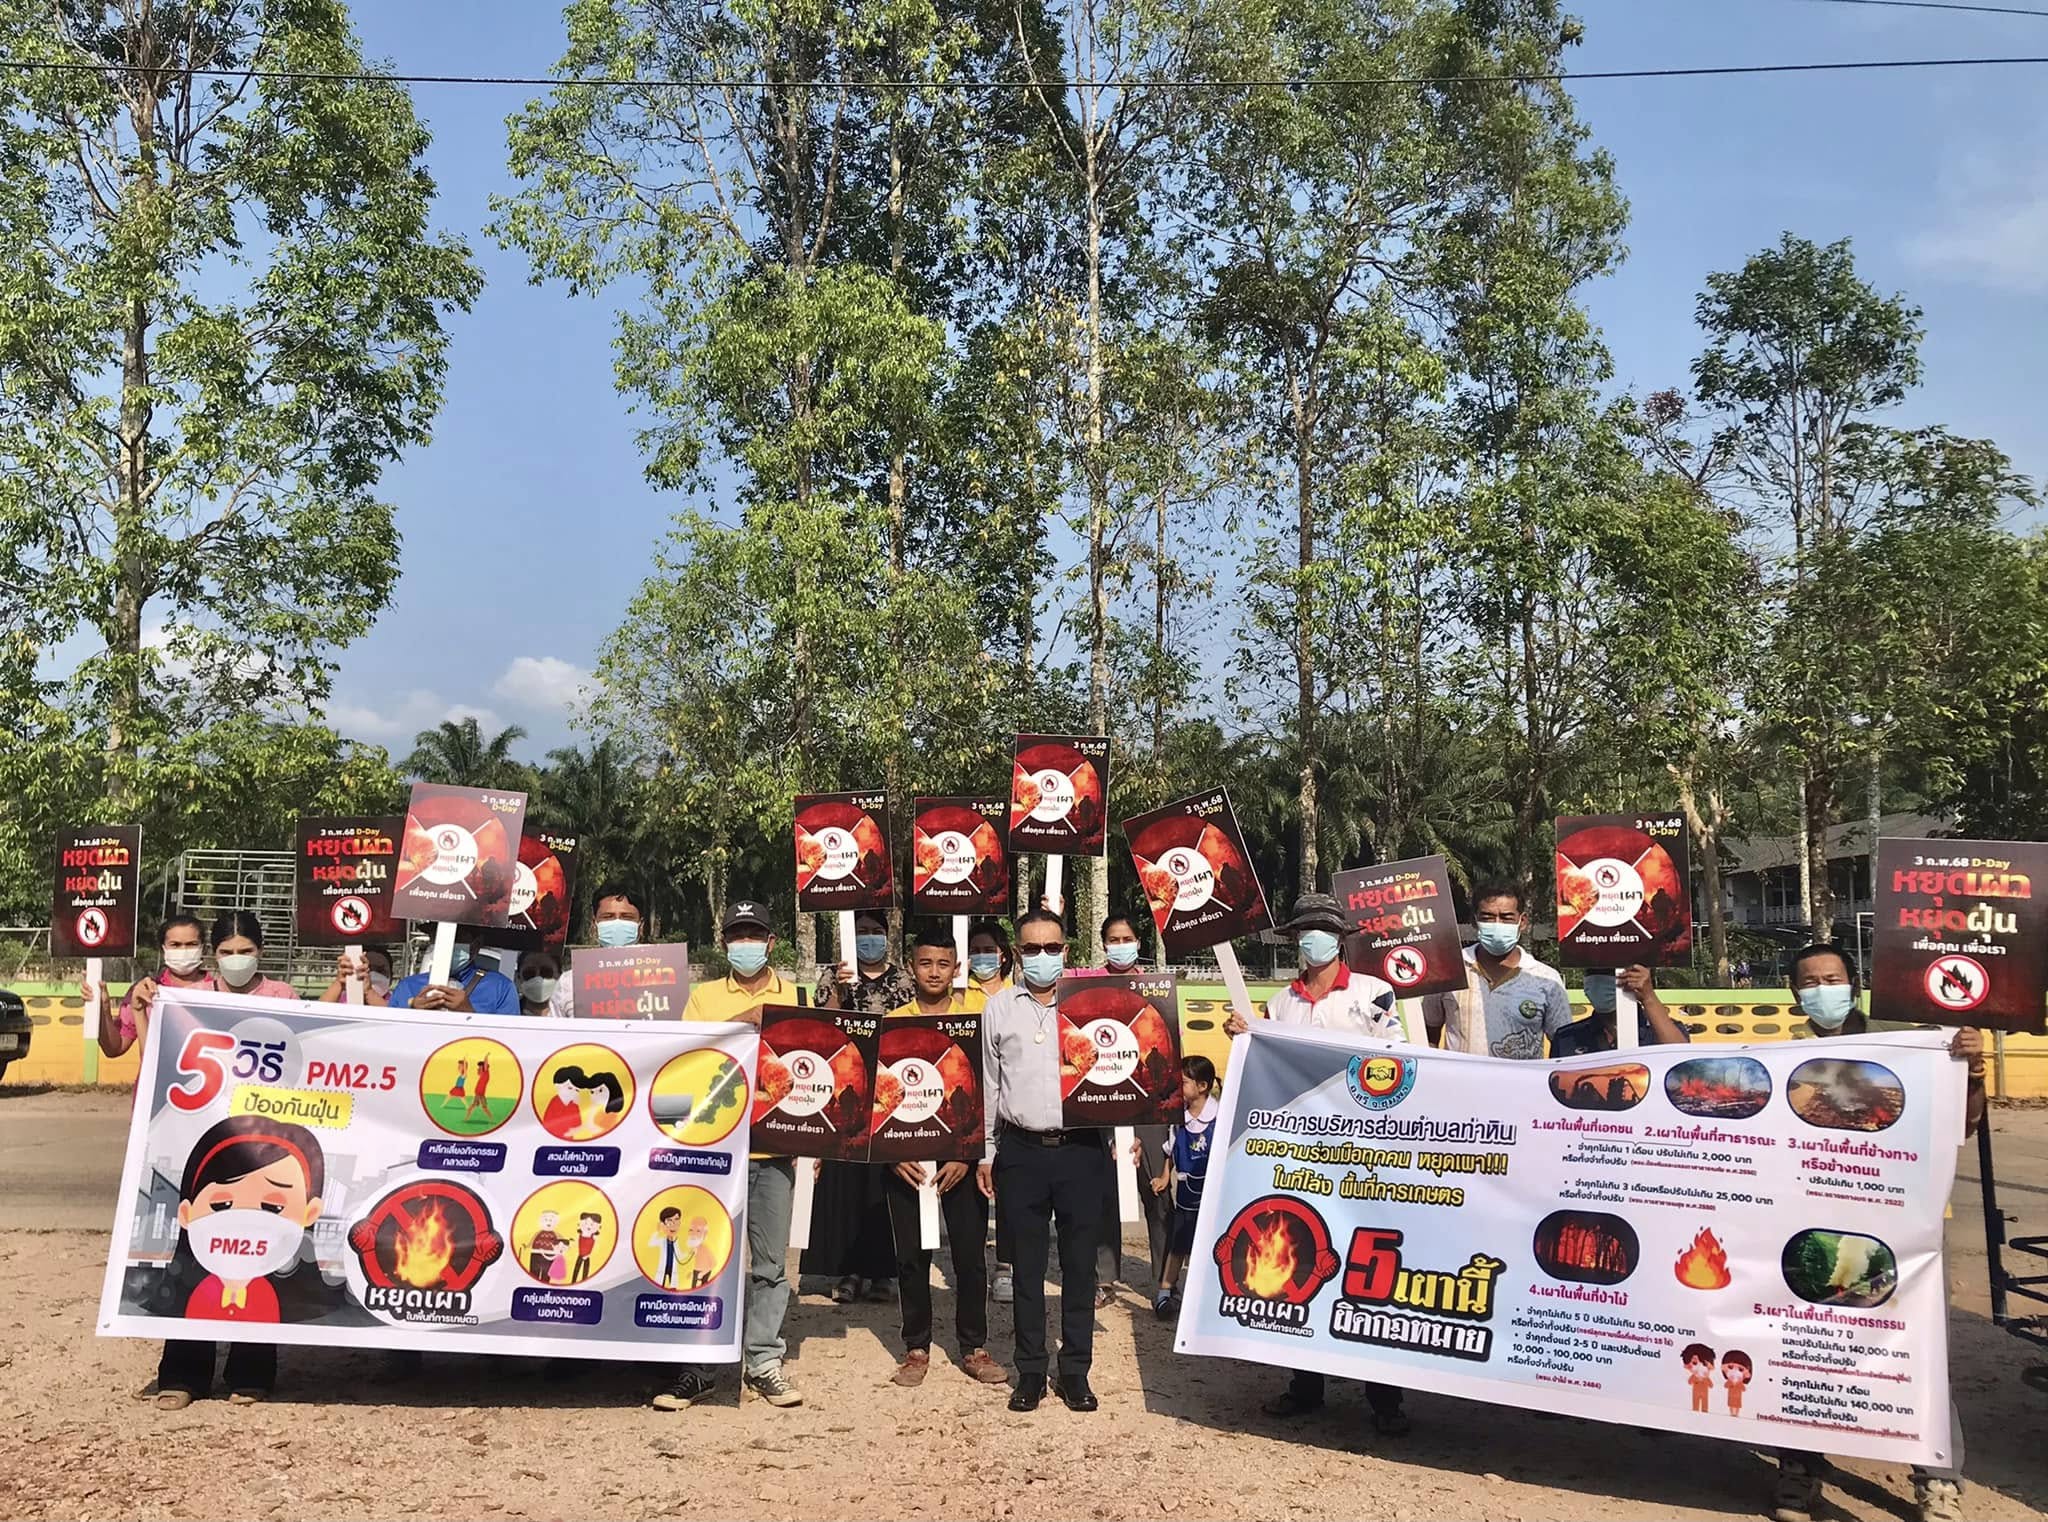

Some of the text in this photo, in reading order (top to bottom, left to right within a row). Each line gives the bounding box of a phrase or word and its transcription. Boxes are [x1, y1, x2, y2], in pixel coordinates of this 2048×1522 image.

[307, 838, 394, 865] หยุดเผา
[1914, 856, 2011, 870] 3 ก.พ.68 D-Day
[1348, 879, 1438, 915] หยุดเผา
[1892, 870, 2032, 907] หยุดเผา
[584, 966, 677, 997] หยุดเผา
[1130, 980, 1171, 990] 3 ก.พ.68
[1142, 988, 1170, 998] D-Day
[835, 1017, 877, 1029] 3 ก.พ.68
[846, 1026, 873, 1038] D-Day
[937, 1020, 977, 1030] 3 ก.พ.68
[949, 1028, 975, 1038] D-Day
[168, 1031, 398, 1111] 5 วิธี PM2.5
[243, 1092, 339, 1124] ป้องกันฝุ่น
[1248, 1109, 1515, 1142] องค์การบริหารส่วนตำบลท่าหิน
[1531, 1116, 1633, 1135] 1.เผาในพื้นที่เอกชน
[1644, 1124, 1777, 1147] 2.เผาในพื้นที่สาธารณะ
[1246, 1138, 1509, 1177] ขอความร่วมมือทุกคน หยุดเผา!!!
[1578, 1142, 1622, 1154] จำคุกไม่เกิน
[1632, 1145, 1654, 1156] เดือน
[1656, 1148, 1699, 1160] ปรับไม่เกิน
[1702, 1152, 1732, 1162] 2,000
[1734, 1156, 1752, 1165] บาท
[1788, 1137, 1918, 1162] 3.เผาในพื้นที่ข้างทาง
[1801, 1157, 1881, 1177] หรือข้างถนน
[1339, 1172, 1464, 1207] พื้นที่การเกษตร
[1575, 1178, 1620, 1190] จำคุกไม่เกิน
[1622, 1182, 1628, 1191] 3
[1716, 1190, 1753, 1203] 25,000
[1755, 1196, 1774, 1206] บาท
[1809, 1176, 1905, 1195] ปรับไม่เกิน 1,000 บาท
[209, 1237, 269, 1257] PM2.5
[368, 1287, 468, 1314] หยุดเผา
[1528, 1284, 1629, 1306] 4.เผาในพื้นที่ป่าไม้
[1221, 1294, 1306, 1322] หยุดเผา
[1753, 1303, 1905, 1331] 5.เผาในพื้นที่เกษตรกรรม
[1527, 1306, 1572, 1320] จำคุกไม่เกิน
[1574, 1312, 1581, 1321] 5
[1583, 1312, 1590, 1322] ปี
[1592, 1315, 1635, 1328] ปรับไม่เกิน
[1637, 1321, 1675, 1334] 50,000
[1677, 1327, 1696, 1337] บาท
[1782, 1322, 1854, 1340] จำคุกไม่เกิน 7 ปี
[1512, 1343, 1544, 1354] 10,000
[1553, 1348, 1593, 1362] 100,000
[1595, 1355, 1613, 1365] บาท
[1525, 1331, 1571, 1345] จำคุกตั้งแต่
[1573, 1338, 1589, 1348] 2-5
[1591, 1339, 1598, 1349] ปี
[1600, 1343, 1661, 1358] และปรับตั้งแต่
[1782, 1337, 1910, 1360] และปรับไม่เกิน 140,000 บาท
[1782, 1376, 1870, 1396] จำคุกไม่เกิน 7 เดือน
[1781, 1391, 1914, 1416] หรือปรับไม่เกิน 140,000 บาท
